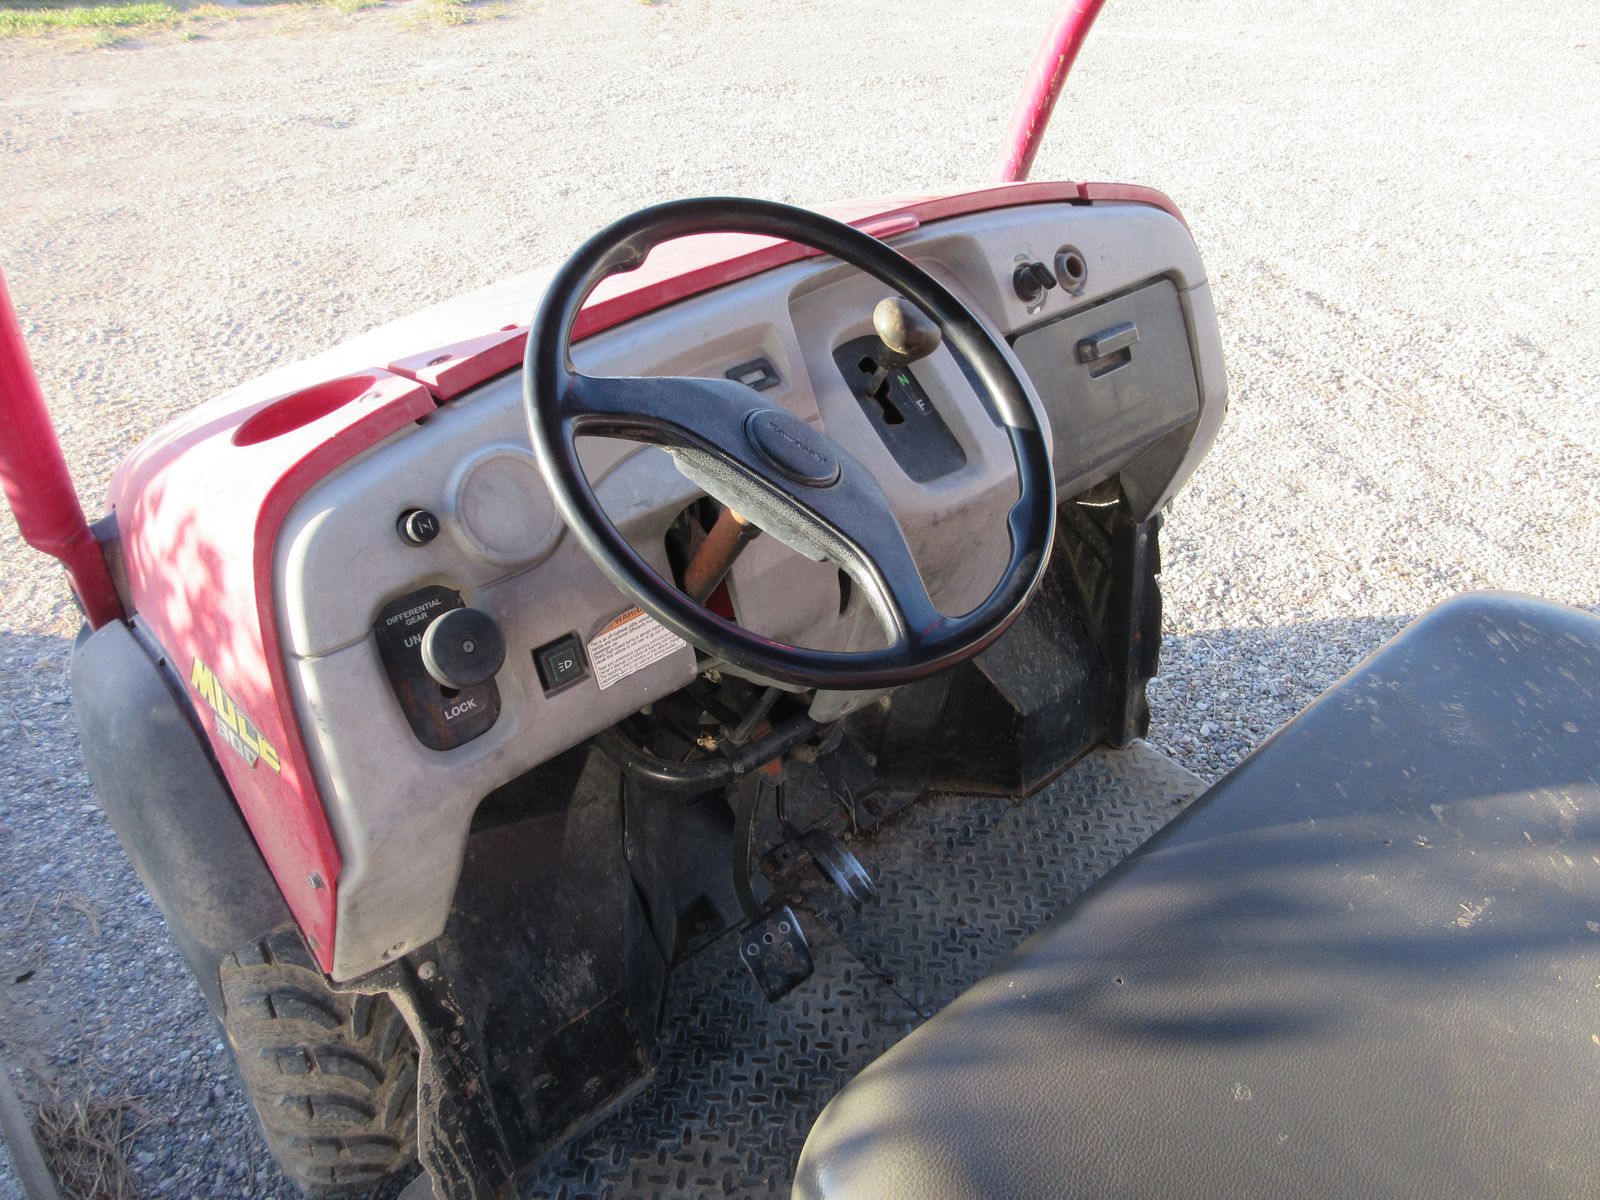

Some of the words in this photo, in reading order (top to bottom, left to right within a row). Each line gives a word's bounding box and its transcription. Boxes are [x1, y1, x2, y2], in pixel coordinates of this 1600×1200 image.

[386, 598, 442, 626] DIFFERENTIAL
[405, 612, 428, 626] GEAR
[404, 633, 422, 648] UN
[191, 656, 281, 773] MULE
[444, 698, 477, 720] LOCK
